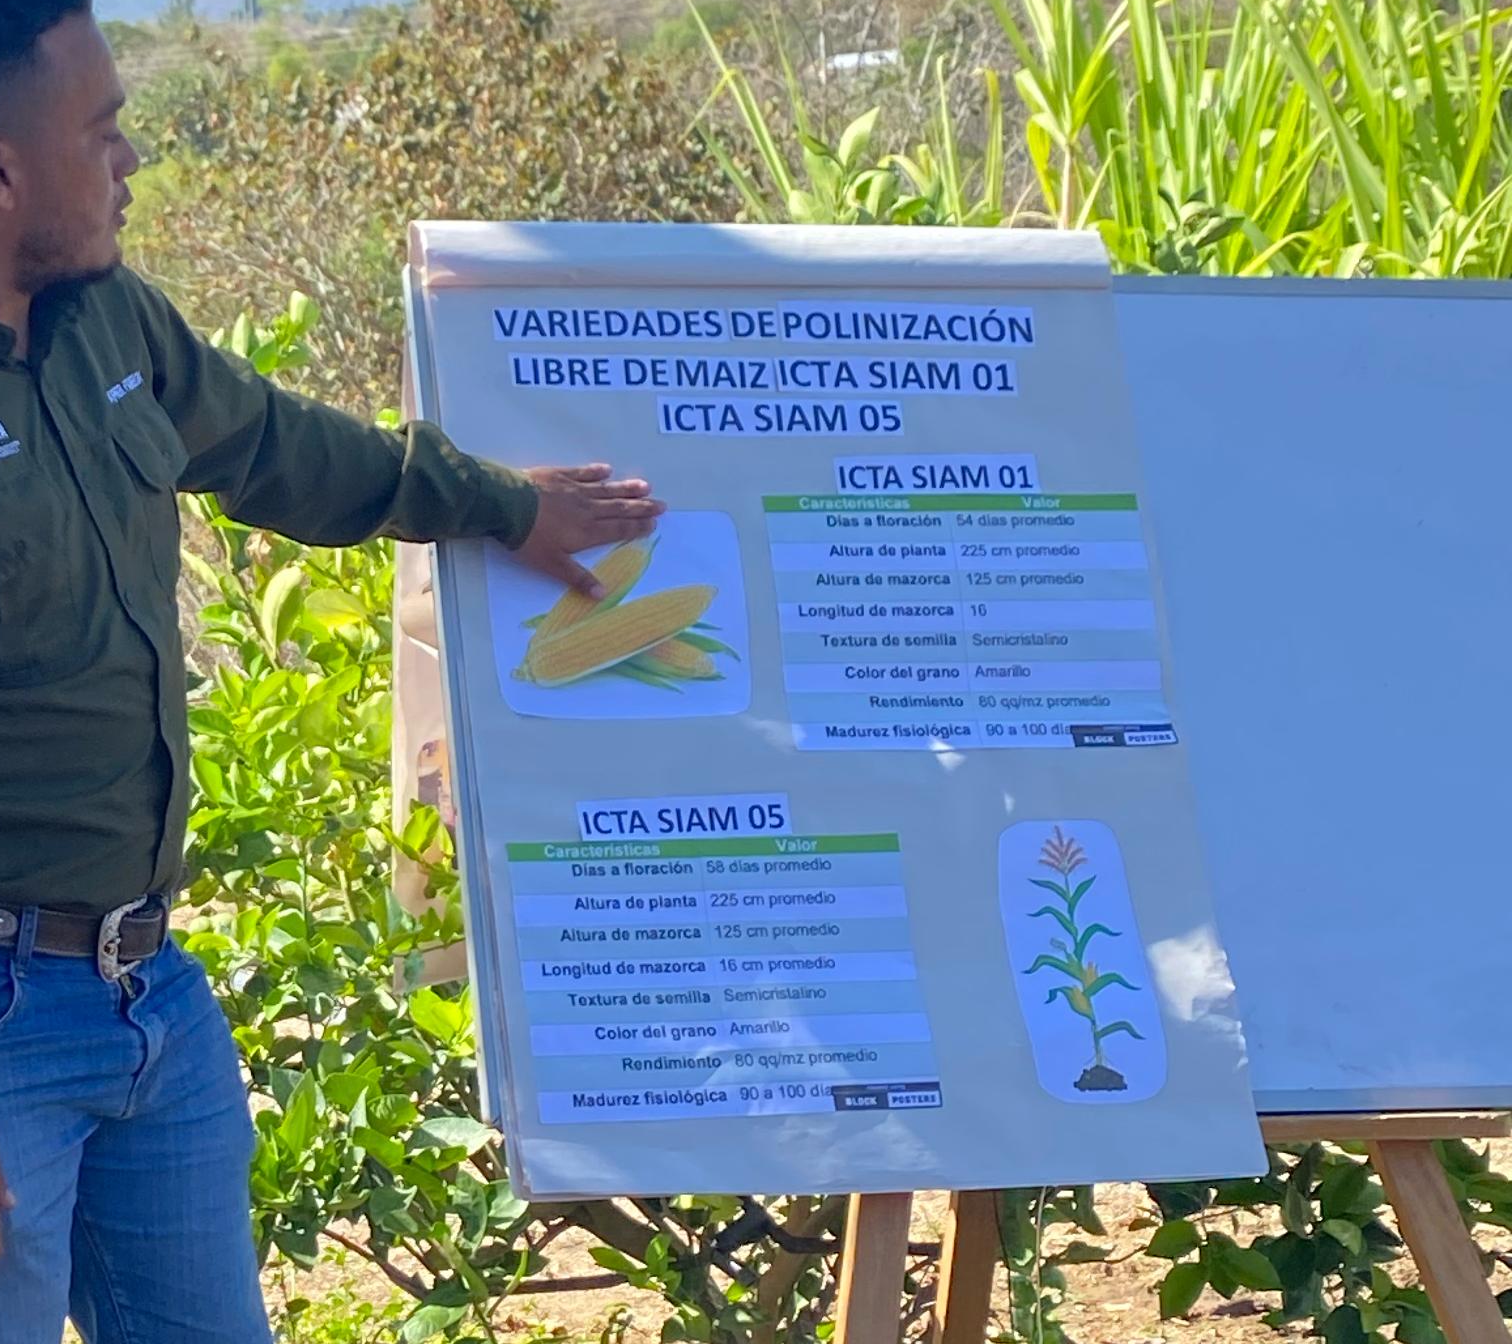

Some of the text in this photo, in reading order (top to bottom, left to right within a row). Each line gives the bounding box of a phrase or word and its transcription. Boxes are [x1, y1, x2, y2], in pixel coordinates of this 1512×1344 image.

[494, 309, 1034, 343] VARIEDADES DE POLINIZACIÓN
[513, 357, 1014, 391] LIBRE DE MAIZ ICTA SIAM 01
[662, 404, 901, 432] ICTA SIAM 05
[839, 465, 1033, 489] ICTA SIAM 01
[1021, 496, 1061, 509] Valor
[864, 517, 873, 527] a
[876, 513, 941, 527] floración
[956, 514, 973, 527] 54
[1011, 514, 1075, 529] promedio
[829, 544, 1080, 559] Altura de planta 225 cm promedio
[815, 573, 1084, 588] Altura de mazorca 125 cm promedio
[798, 604, 865, 620] Longitud
[869, 604, 887, 617] de
[891, 606, 954, 617] mazorca
[821, 633, 1068, 647] Textura de semilla Semicristalino
[844, 665, 1031, 681] Color del grano Amarillo
[869, 696, 964, 708] Rendimiento
[1046, 695, 1111, 709] promedio
[825, 725, 888, 738] Madurez
[893, 724, 971, 739] fisiológica
[1009, 726, 1018, 735] a
[1021, 724, 1047, 736] 100
[582, 804, 785, 834] ICTA SIAM 05
[775, 839, 818, 852] Valor
[611, 865, 620, 876] a
[624, 862, 693, 876] floración
[706, 860, 725, 873] 58
[764, 858, 832, 875] promedio
[575, 891, 836, 912] Altura de planta 225 cm promedio
[560, 923, 840, 942] Altura de mazorca 125 cm promedio
[542, 956, 836, 979] Longitud de mazorca 16 cm promedio
[567, 987, 827, 1007] Textura de semilla Semicristalino
[595, 1021, 790, 1041] Color del grano Amarillo
[622, 1048, 878, 1071] Rendimiento 80 qq/mz promedio
[572, 1093, 639, 1107] Madurez
[644, 1089, 727, 1106] fisiológica
[740, 1087, 759, 1100] 90
[764, 1089, 773, 1099] a
[780, 1085, 806, 1099] 100
[845, 1097, 877, 1106] BLOCK
